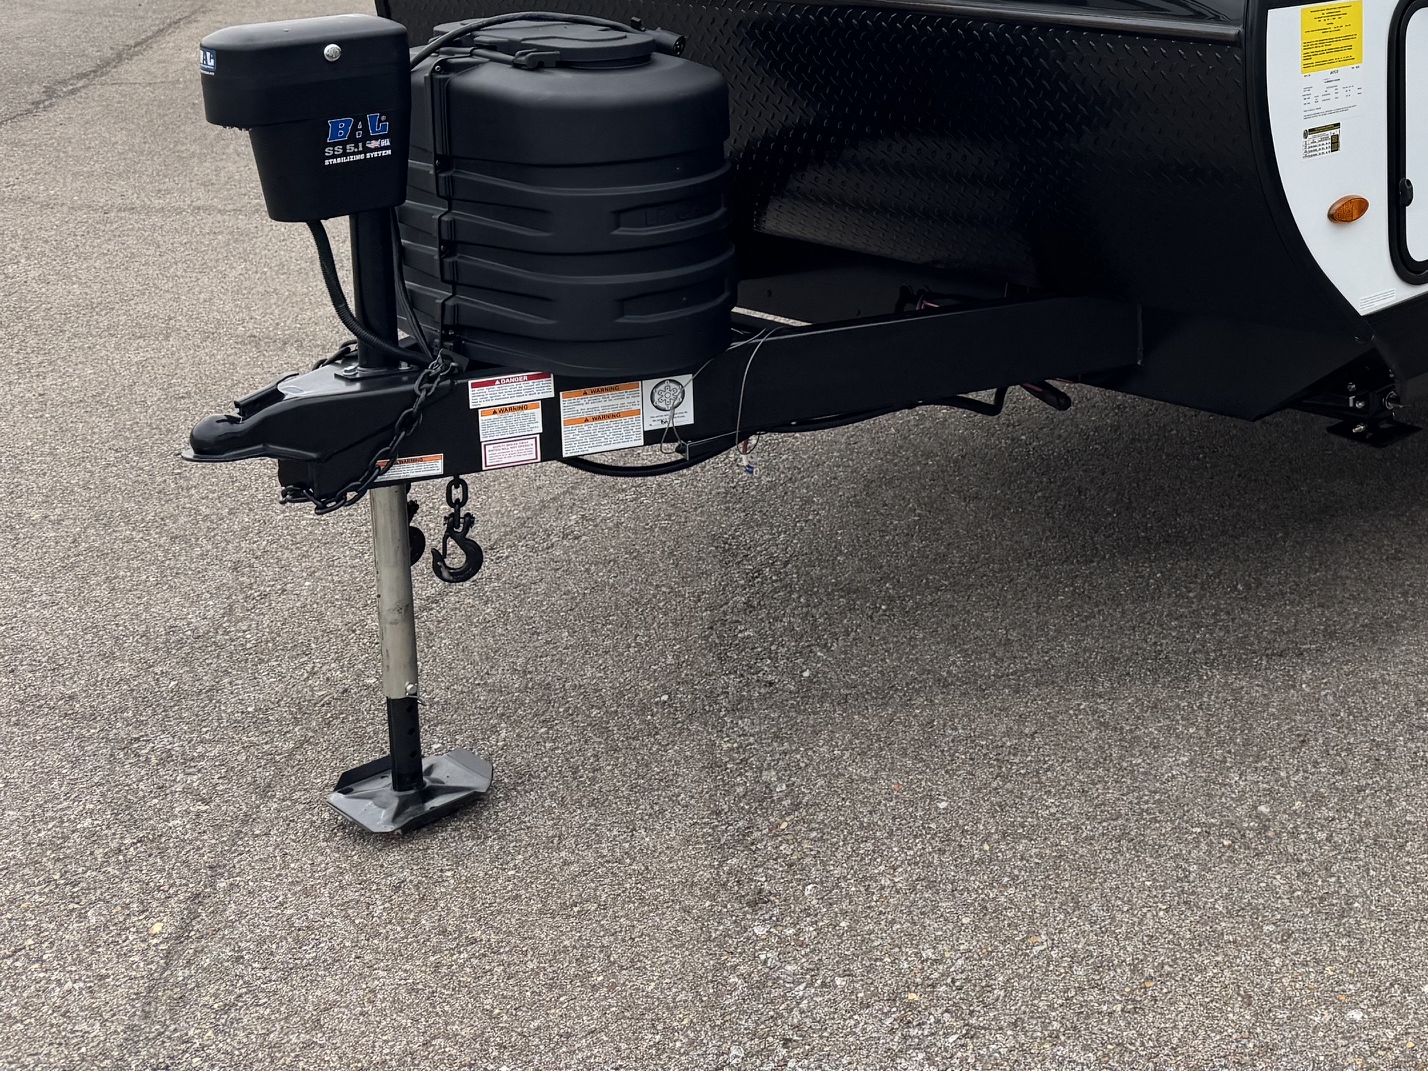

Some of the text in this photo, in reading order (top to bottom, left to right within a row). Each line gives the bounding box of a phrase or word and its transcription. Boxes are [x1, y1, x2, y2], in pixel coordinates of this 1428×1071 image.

[324, 146, 343, 156] SS
[324, 149, 392, 166] STABILIZING SYSTEM
[500, 375, 528, 385] DANGER
[590, 385, 620, 395] WARNING
[498, 404, 528, 414] WARNING
[591, 412, 621, 422] WARNING
